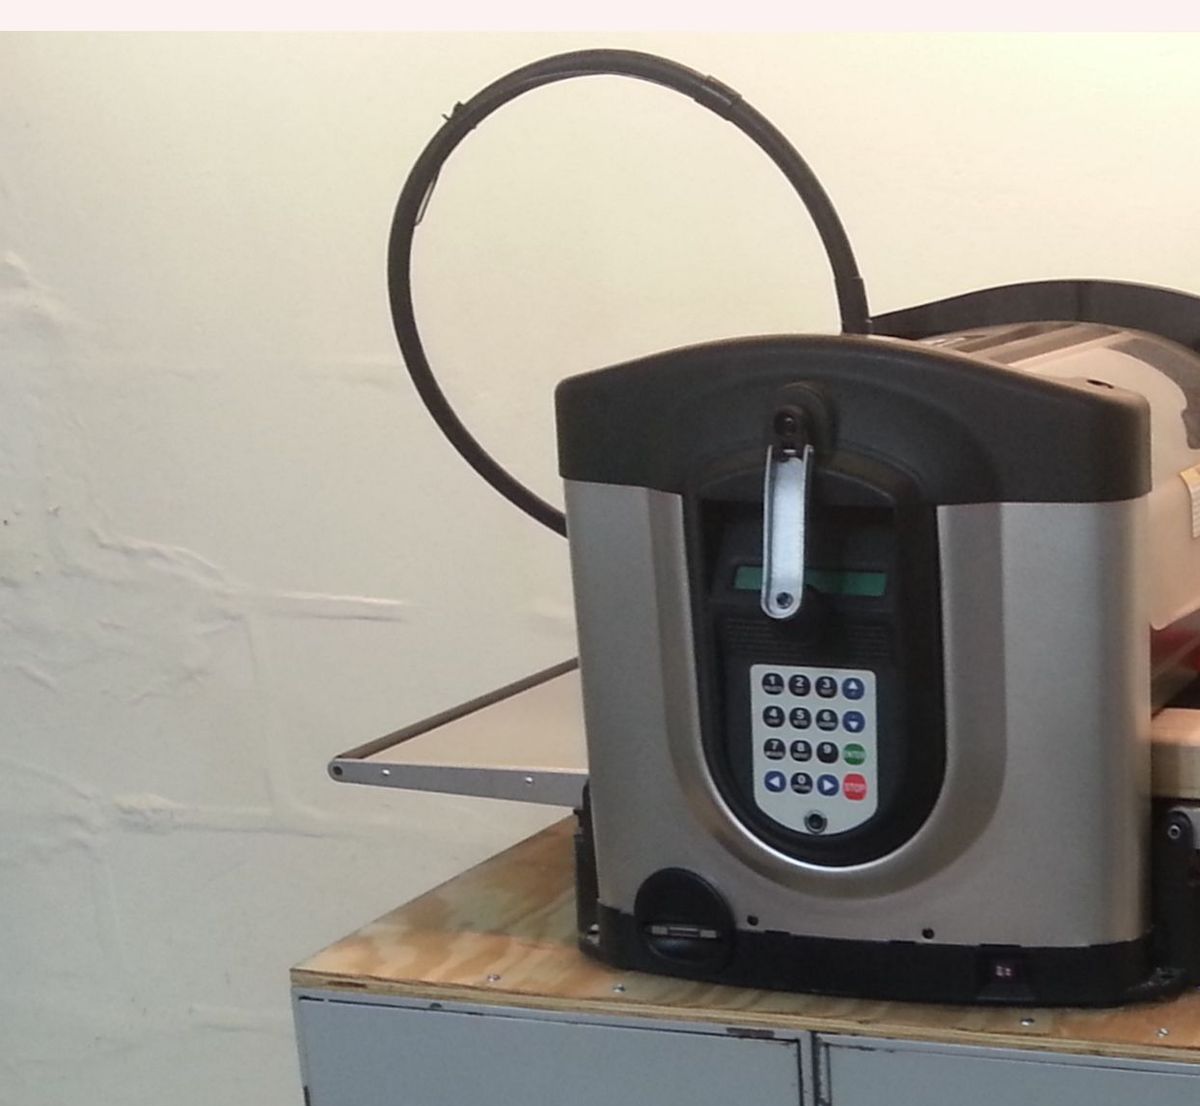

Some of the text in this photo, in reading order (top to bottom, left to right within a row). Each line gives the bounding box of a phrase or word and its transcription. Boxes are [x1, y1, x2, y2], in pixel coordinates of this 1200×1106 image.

[796, 677, 804, 687] 2
[823, 679, 831, 688] 3
[769, 709, 778, 718] 4
[796, 710, 805, 719] 5
[822, 711, 831, 721] 6
[770, 741, 779, 750] 7
[797, 743, 805, 752] 8
[823, 744, 832, 754] 9
